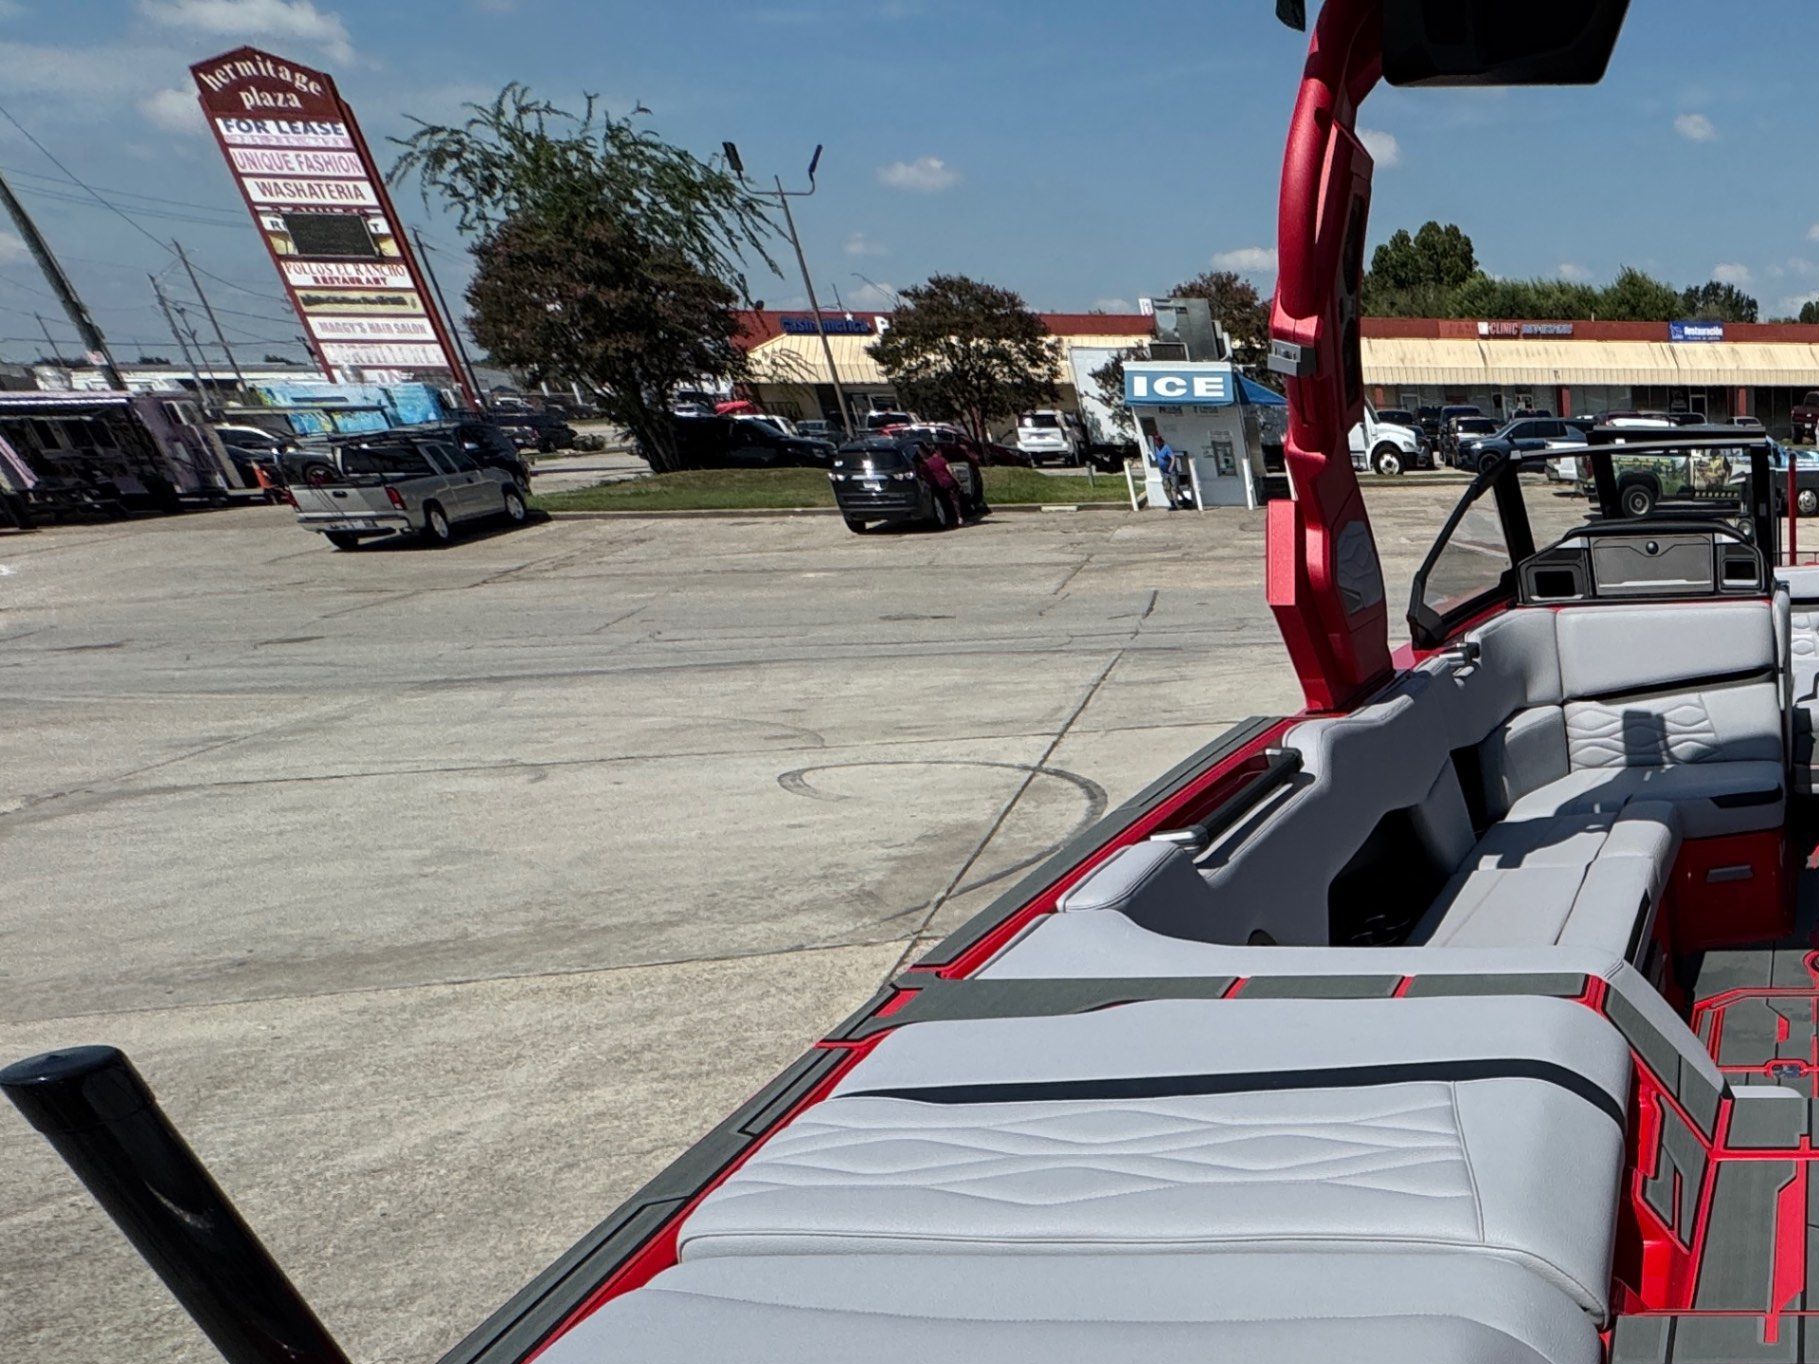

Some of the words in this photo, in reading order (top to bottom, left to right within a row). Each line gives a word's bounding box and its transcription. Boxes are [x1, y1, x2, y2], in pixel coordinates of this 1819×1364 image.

[198, 54, 323, 96] hermitage
[239, 86, 302, 110] plaza
[222, 119, 270, 134] FOR
[275, 120, 345, 136] LEASE
[231, 152, 295, 172] UNIQUE
[294, 153, 362, 174] FASHION
[254, 181, 367, 201] WASHATERIA
[1133, 376, 1225, 397] ICE
